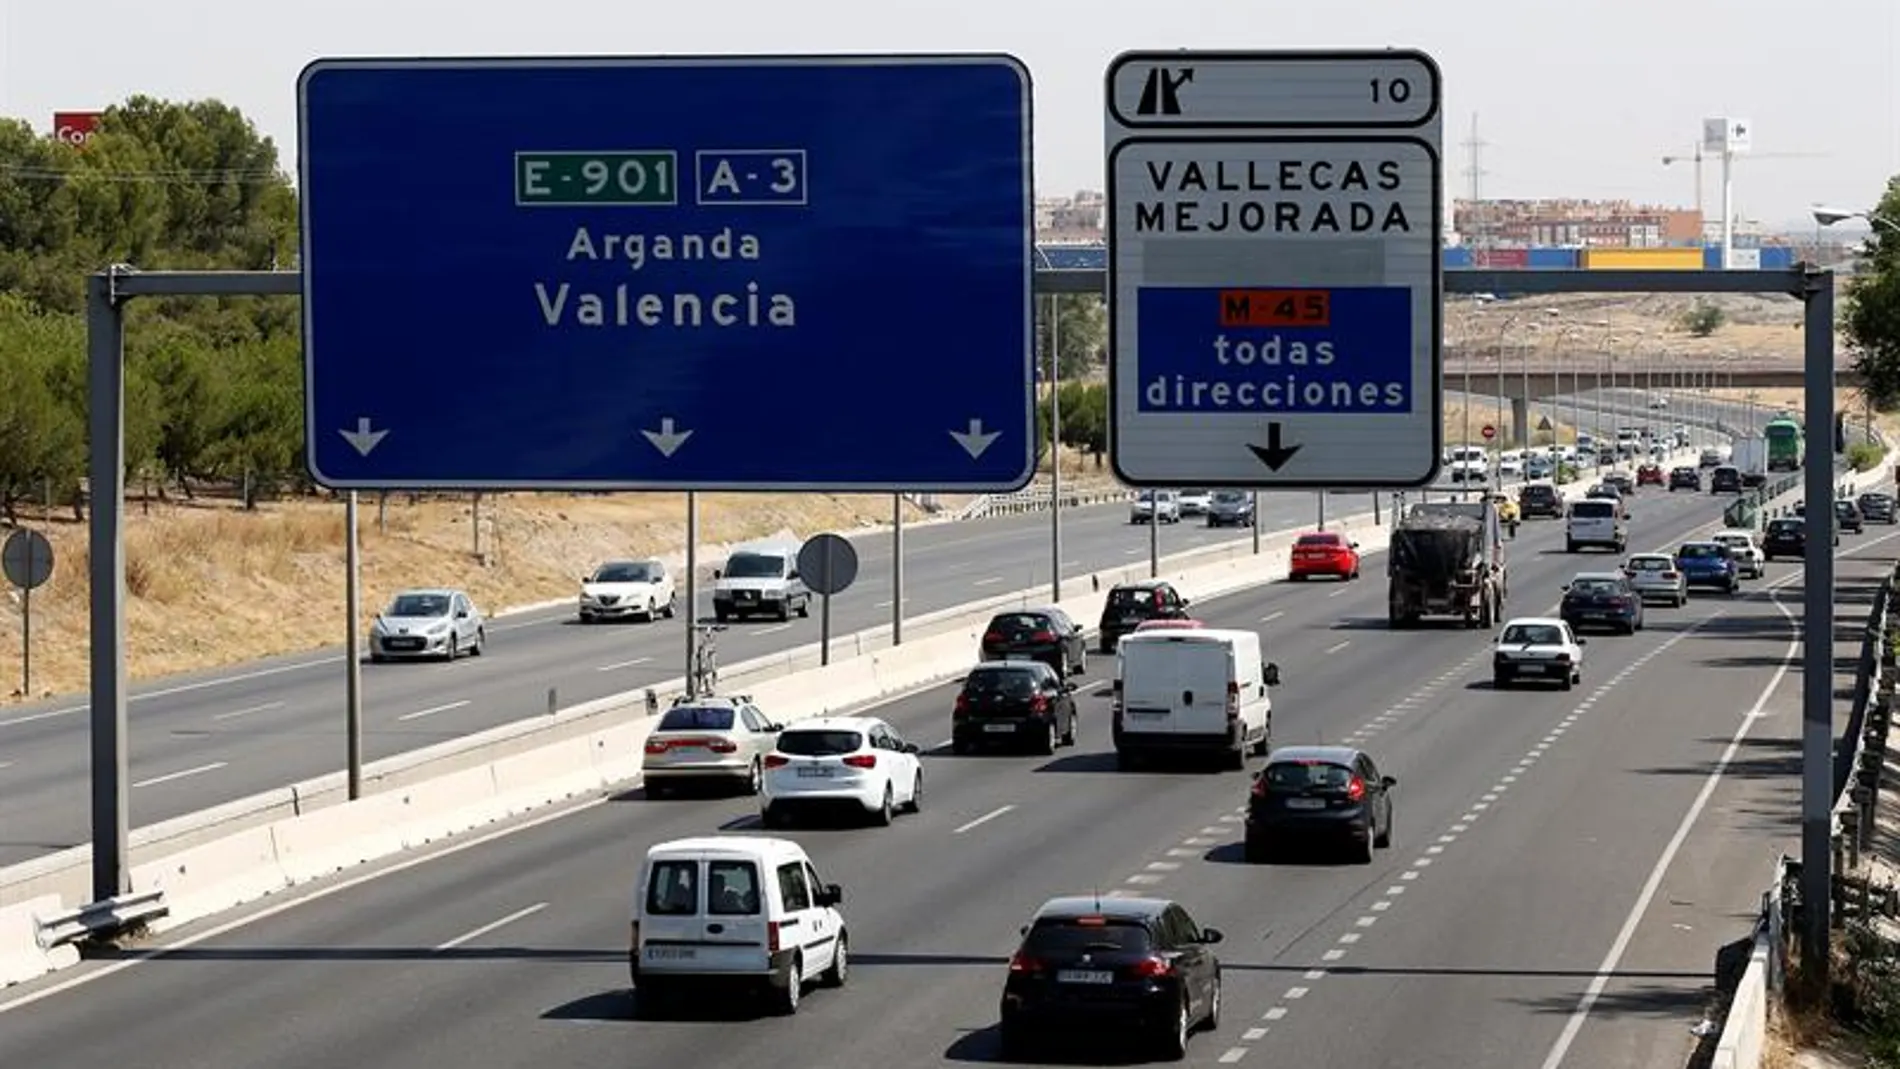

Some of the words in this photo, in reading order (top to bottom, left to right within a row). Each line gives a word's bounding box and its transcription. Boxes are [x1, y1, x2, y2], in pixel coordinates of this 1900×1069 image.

[1370, 78, 1410, 103] 10
[524, 159, 668, 195] E-901
[707, 158, 797, 194] A-3
[1147, 160, 1401, 191] VALLECAS
[1135, 202, 1410, 232] MEJORADA
[566, 226, 760, 271] Arganda
[534, 281, 796, 326] Valencia
[1225, 296, 1325, 321] M-45
[1213, 335, 1335, 365] todas
[1146, 375, 1404, 406] direcciones
